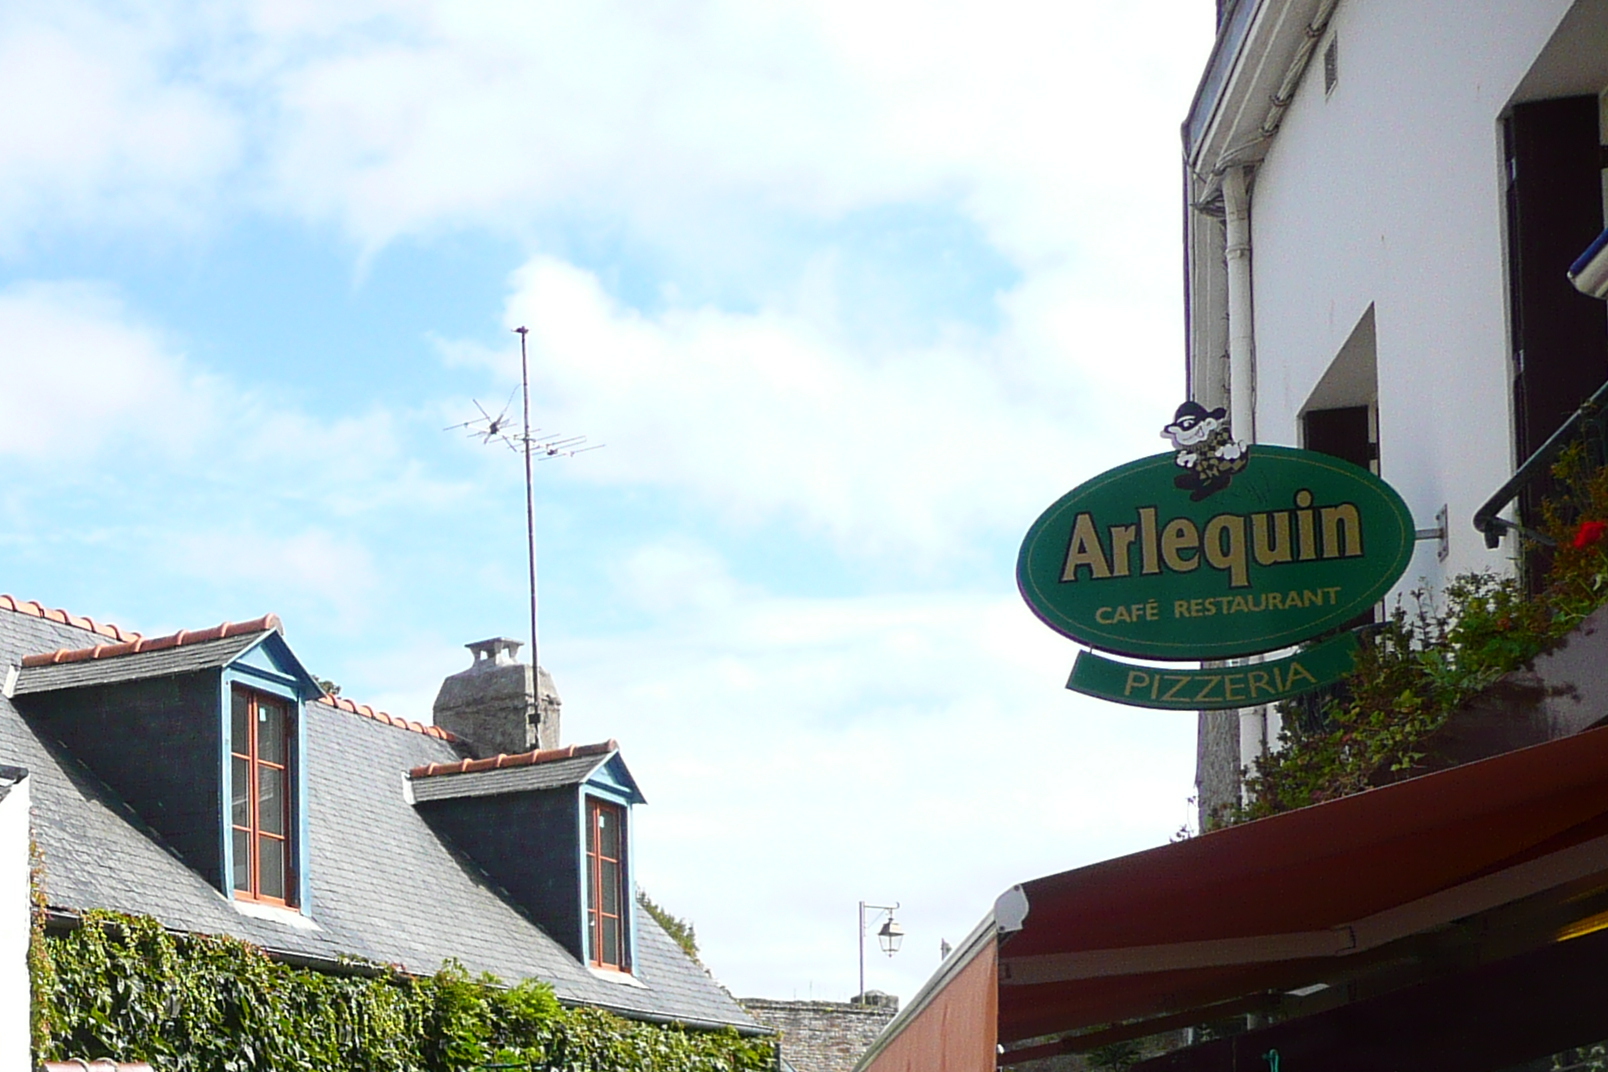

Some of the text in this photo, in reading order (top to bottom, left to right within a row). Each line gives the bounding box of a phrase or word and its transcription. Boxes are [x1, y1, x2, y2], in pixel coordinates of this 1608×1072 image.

[1059, 489, 1364, 587] Arlequin
[1095, 588, 1340, 625] CAFÉ RESTAURANT
[1124, 663, 1317, 701] PIZZERIA
